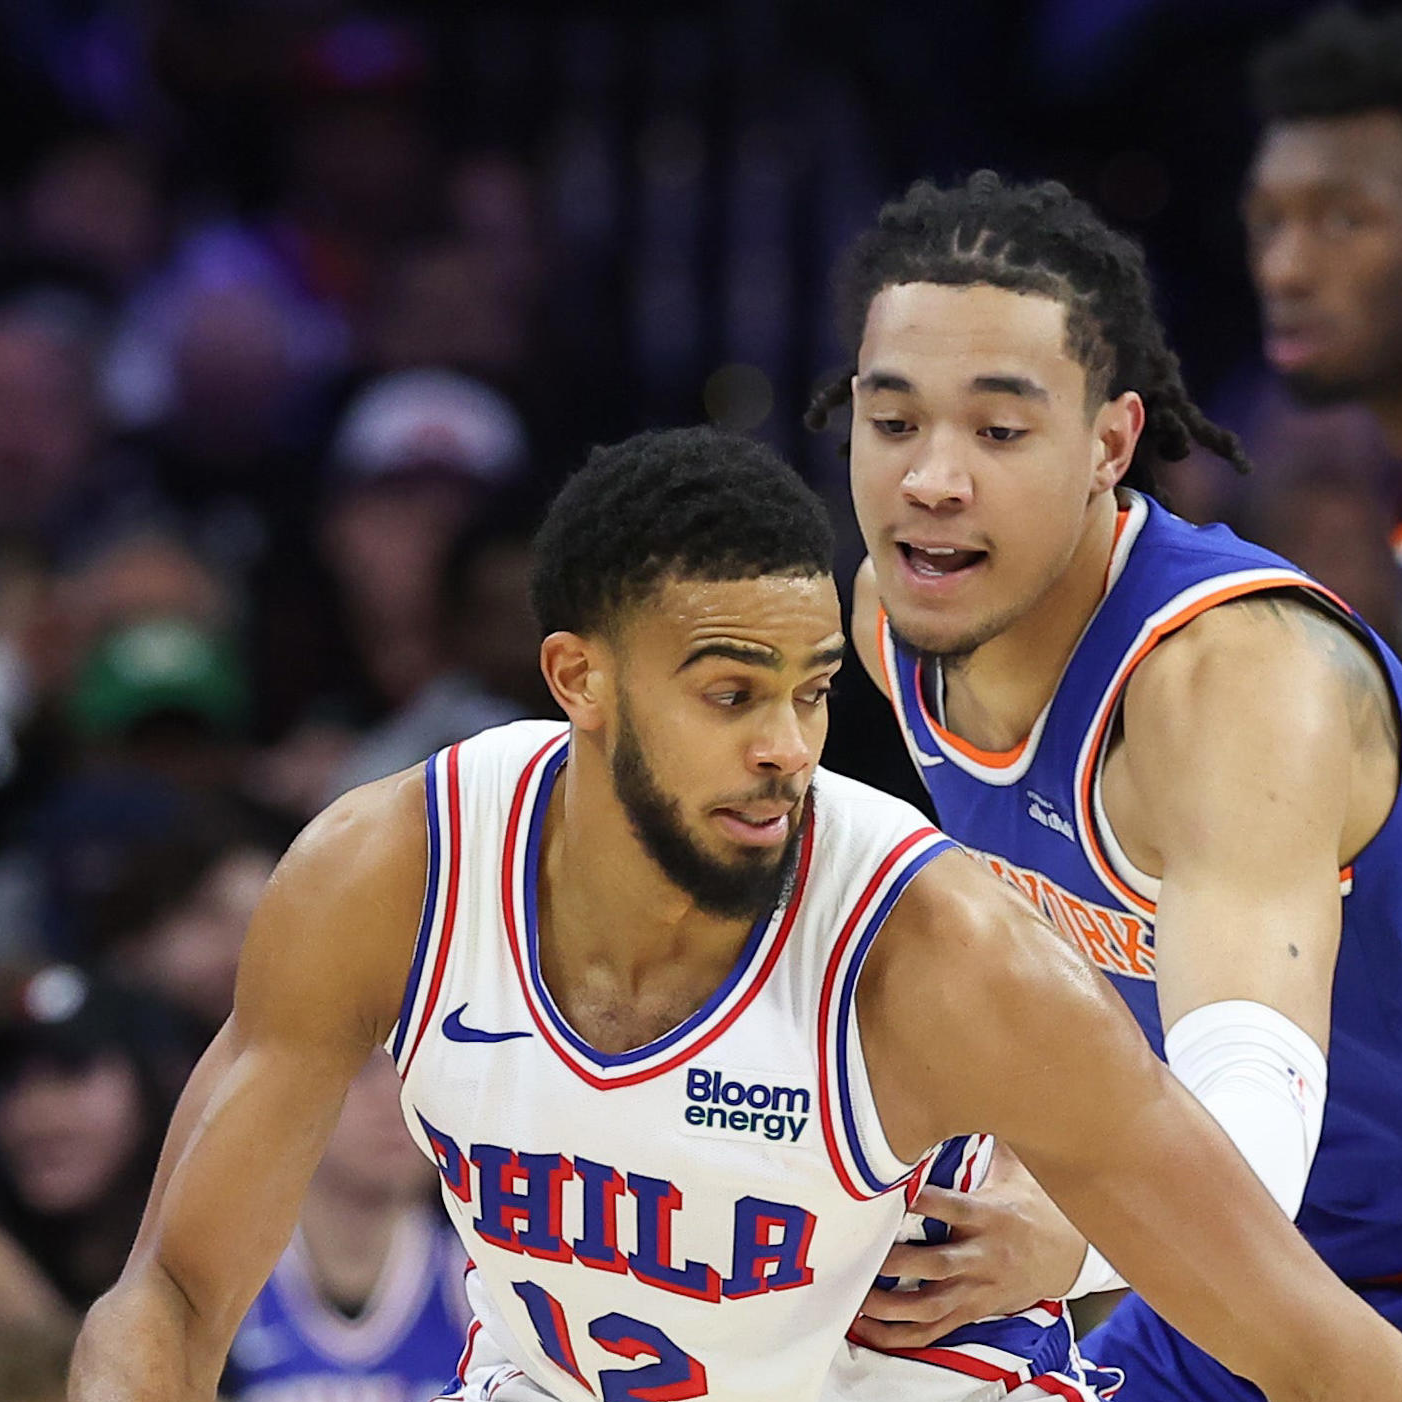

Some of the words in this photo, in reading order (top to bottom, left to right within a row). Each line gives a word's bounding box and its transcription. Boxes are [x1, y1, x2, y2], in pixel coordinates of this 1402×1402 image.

[686, 1067, 810, 1114] Bloom
[684, 1101, 808, 1142] energy
[412, 1103, 816, 1303] PHILA
